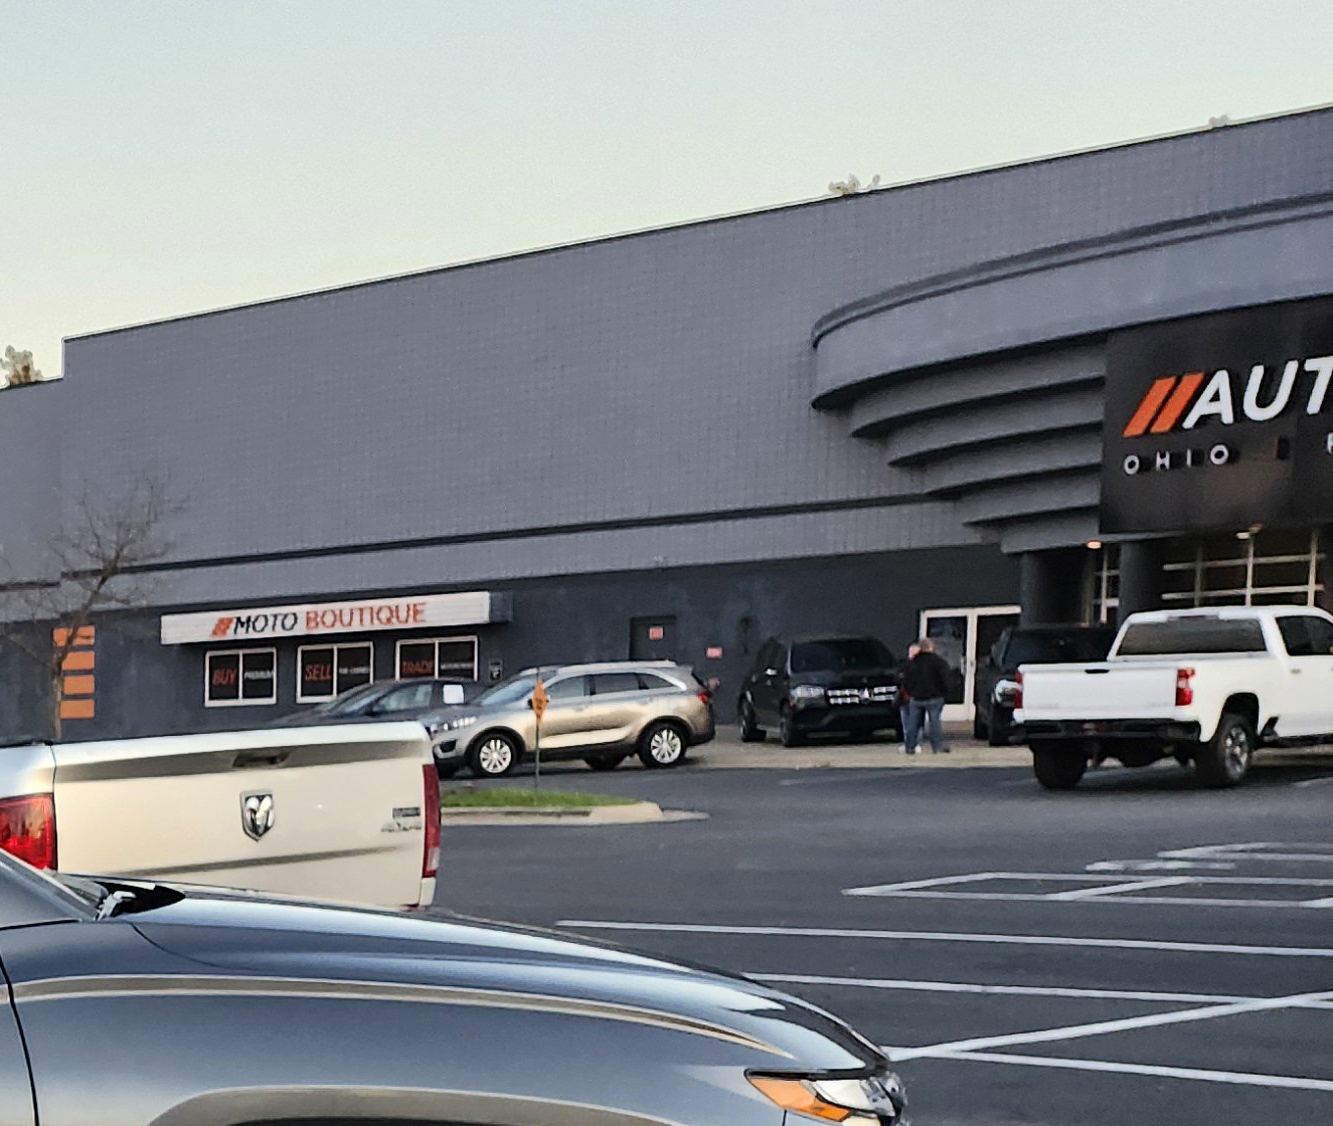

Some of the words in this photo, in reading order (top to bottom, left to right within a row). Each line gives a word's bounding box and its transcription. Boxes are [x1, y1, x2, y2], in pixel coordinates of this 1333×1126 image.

[1123, 443, 1230, 475] OHIO
[232, 612, 298, 635] MOTO
[305, 602, 428, 631] BOUTIQUE
[213, 668, 237, 686] BUY
[305, 664, 331, 681] SELL
